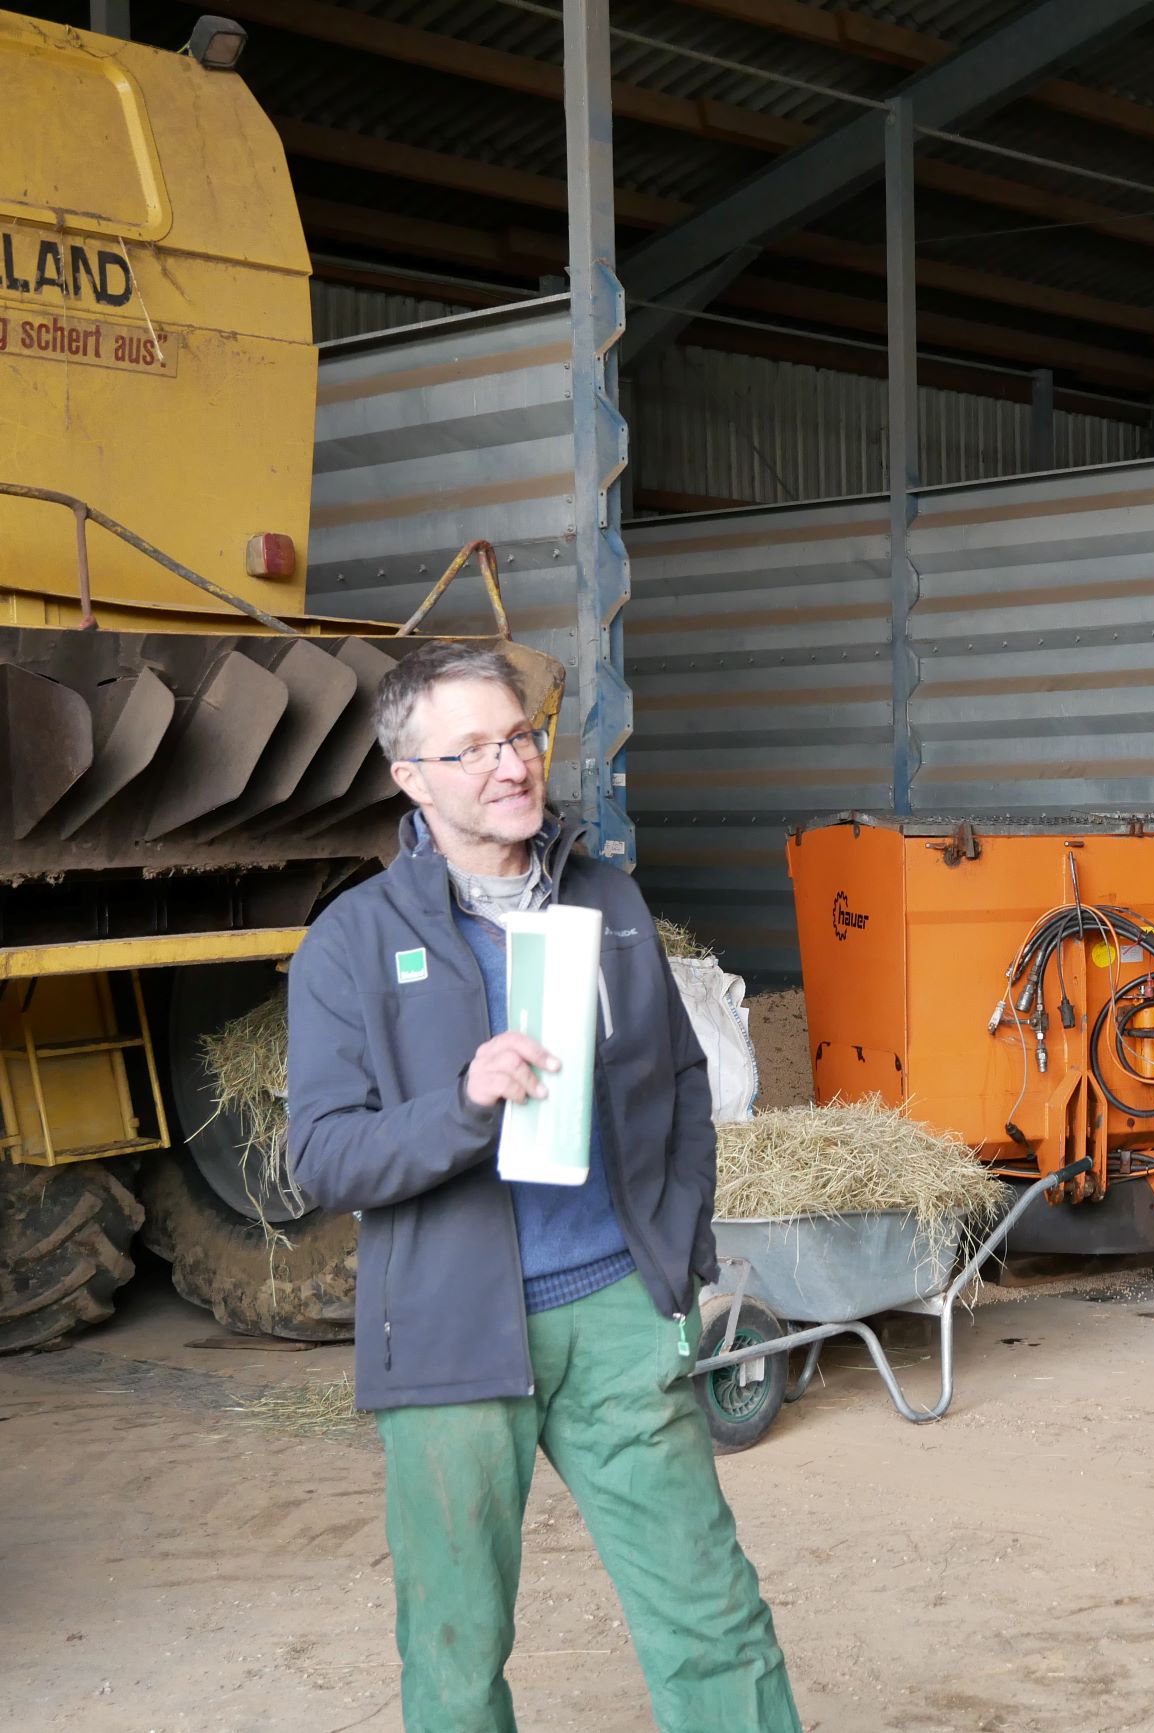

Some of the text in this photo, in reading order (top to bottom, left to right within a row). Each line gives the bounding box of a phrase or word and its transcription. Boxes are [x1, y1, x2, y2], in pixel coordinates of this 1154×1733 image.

[0, 232, 133, 307] LAND
[20, 317, 102, 359] schert
[838, 903, 870, 930] hauer
